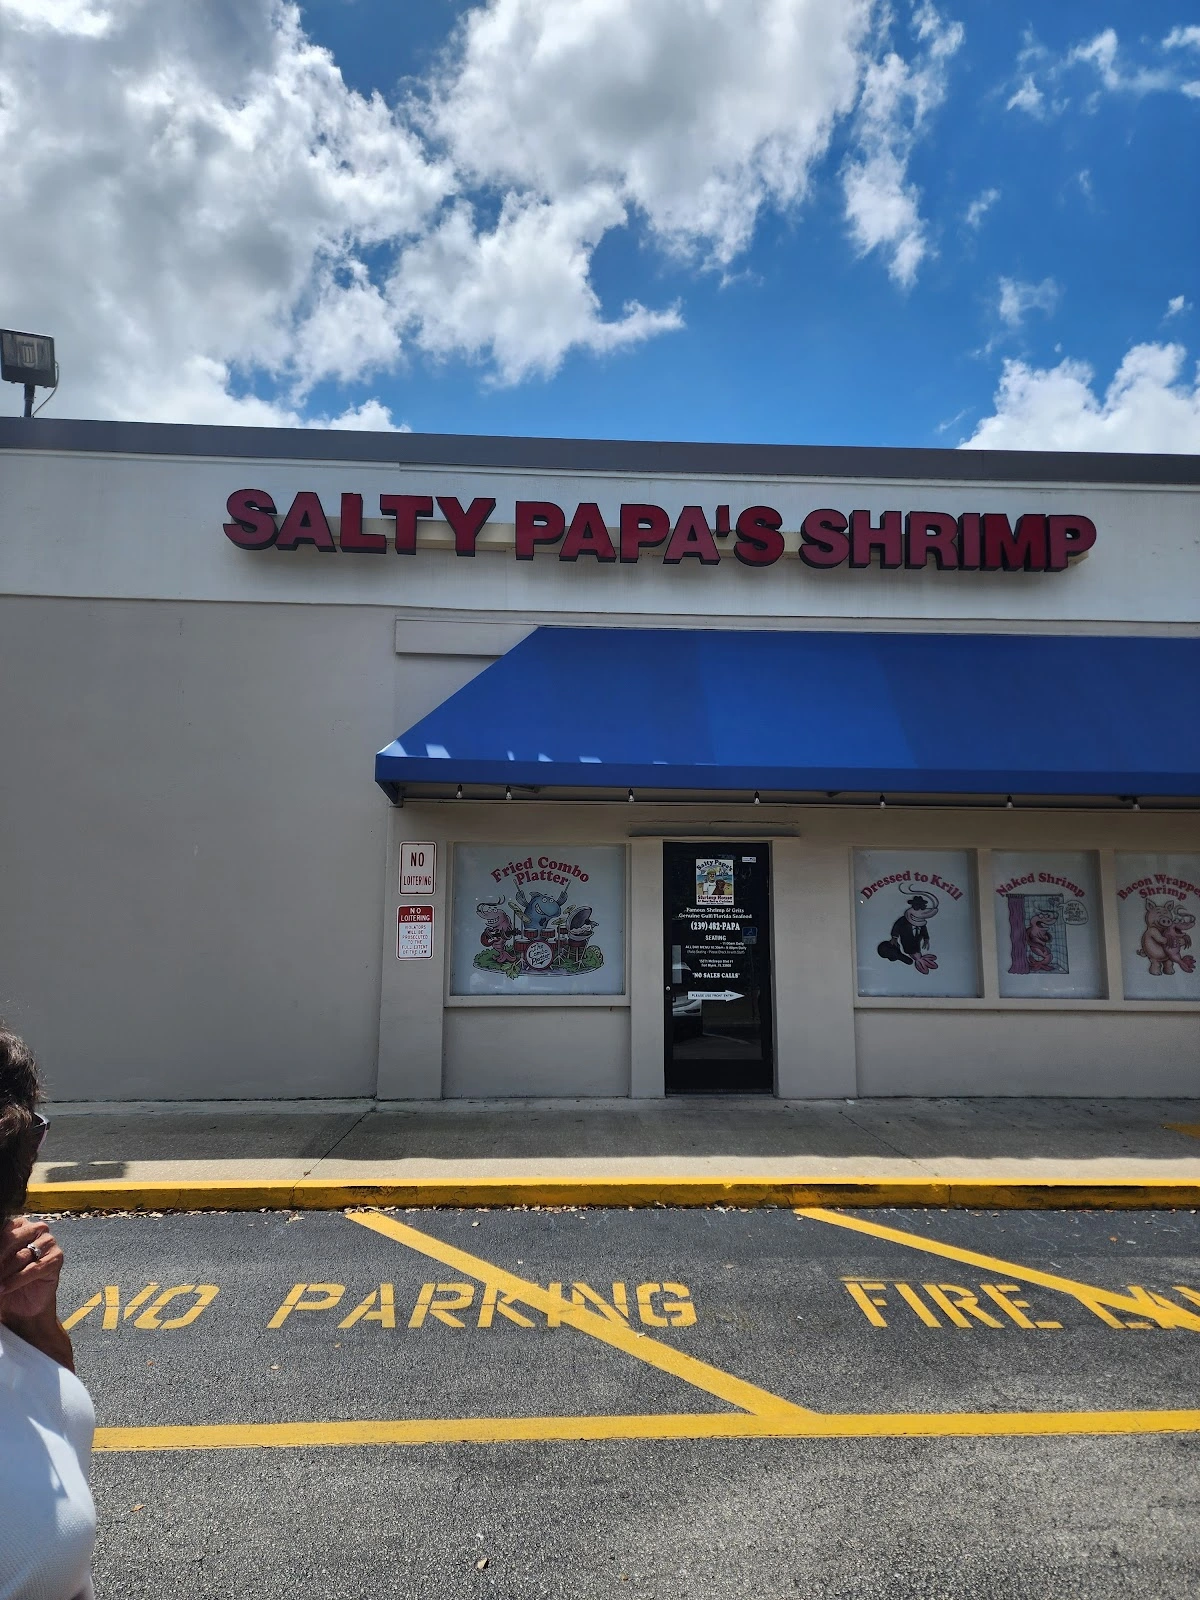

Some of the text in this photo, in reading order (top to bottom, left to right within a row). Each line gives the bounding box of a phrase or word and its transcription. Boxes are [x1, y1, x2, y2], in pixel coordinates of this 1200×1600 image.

[223, 488, 1098, 572] SALTY PAPA'S SHRIMP
[410, 852, 425, 867] NO
[490, 856, 590, 883] Fried Combo
[696, 860, 714, 871] Salty
[403, 876, 432, 886] LOITERING
[515, 869, 569, 886] Platter
[860, 870, 964, 901] Dressed to Krill
[995, 872, 1086, 898] Naked Shrimp
[1116, 877, 1153, 901] Bacon
[1138, 884, 1187, 902] Shrimp
[690, 921, 708, 931] (239)
[64, 1283, 220, 1331] NO
[266, 1282, 698, 1330] PARKING
[844, 1281, 1064, 1330] FIRE
